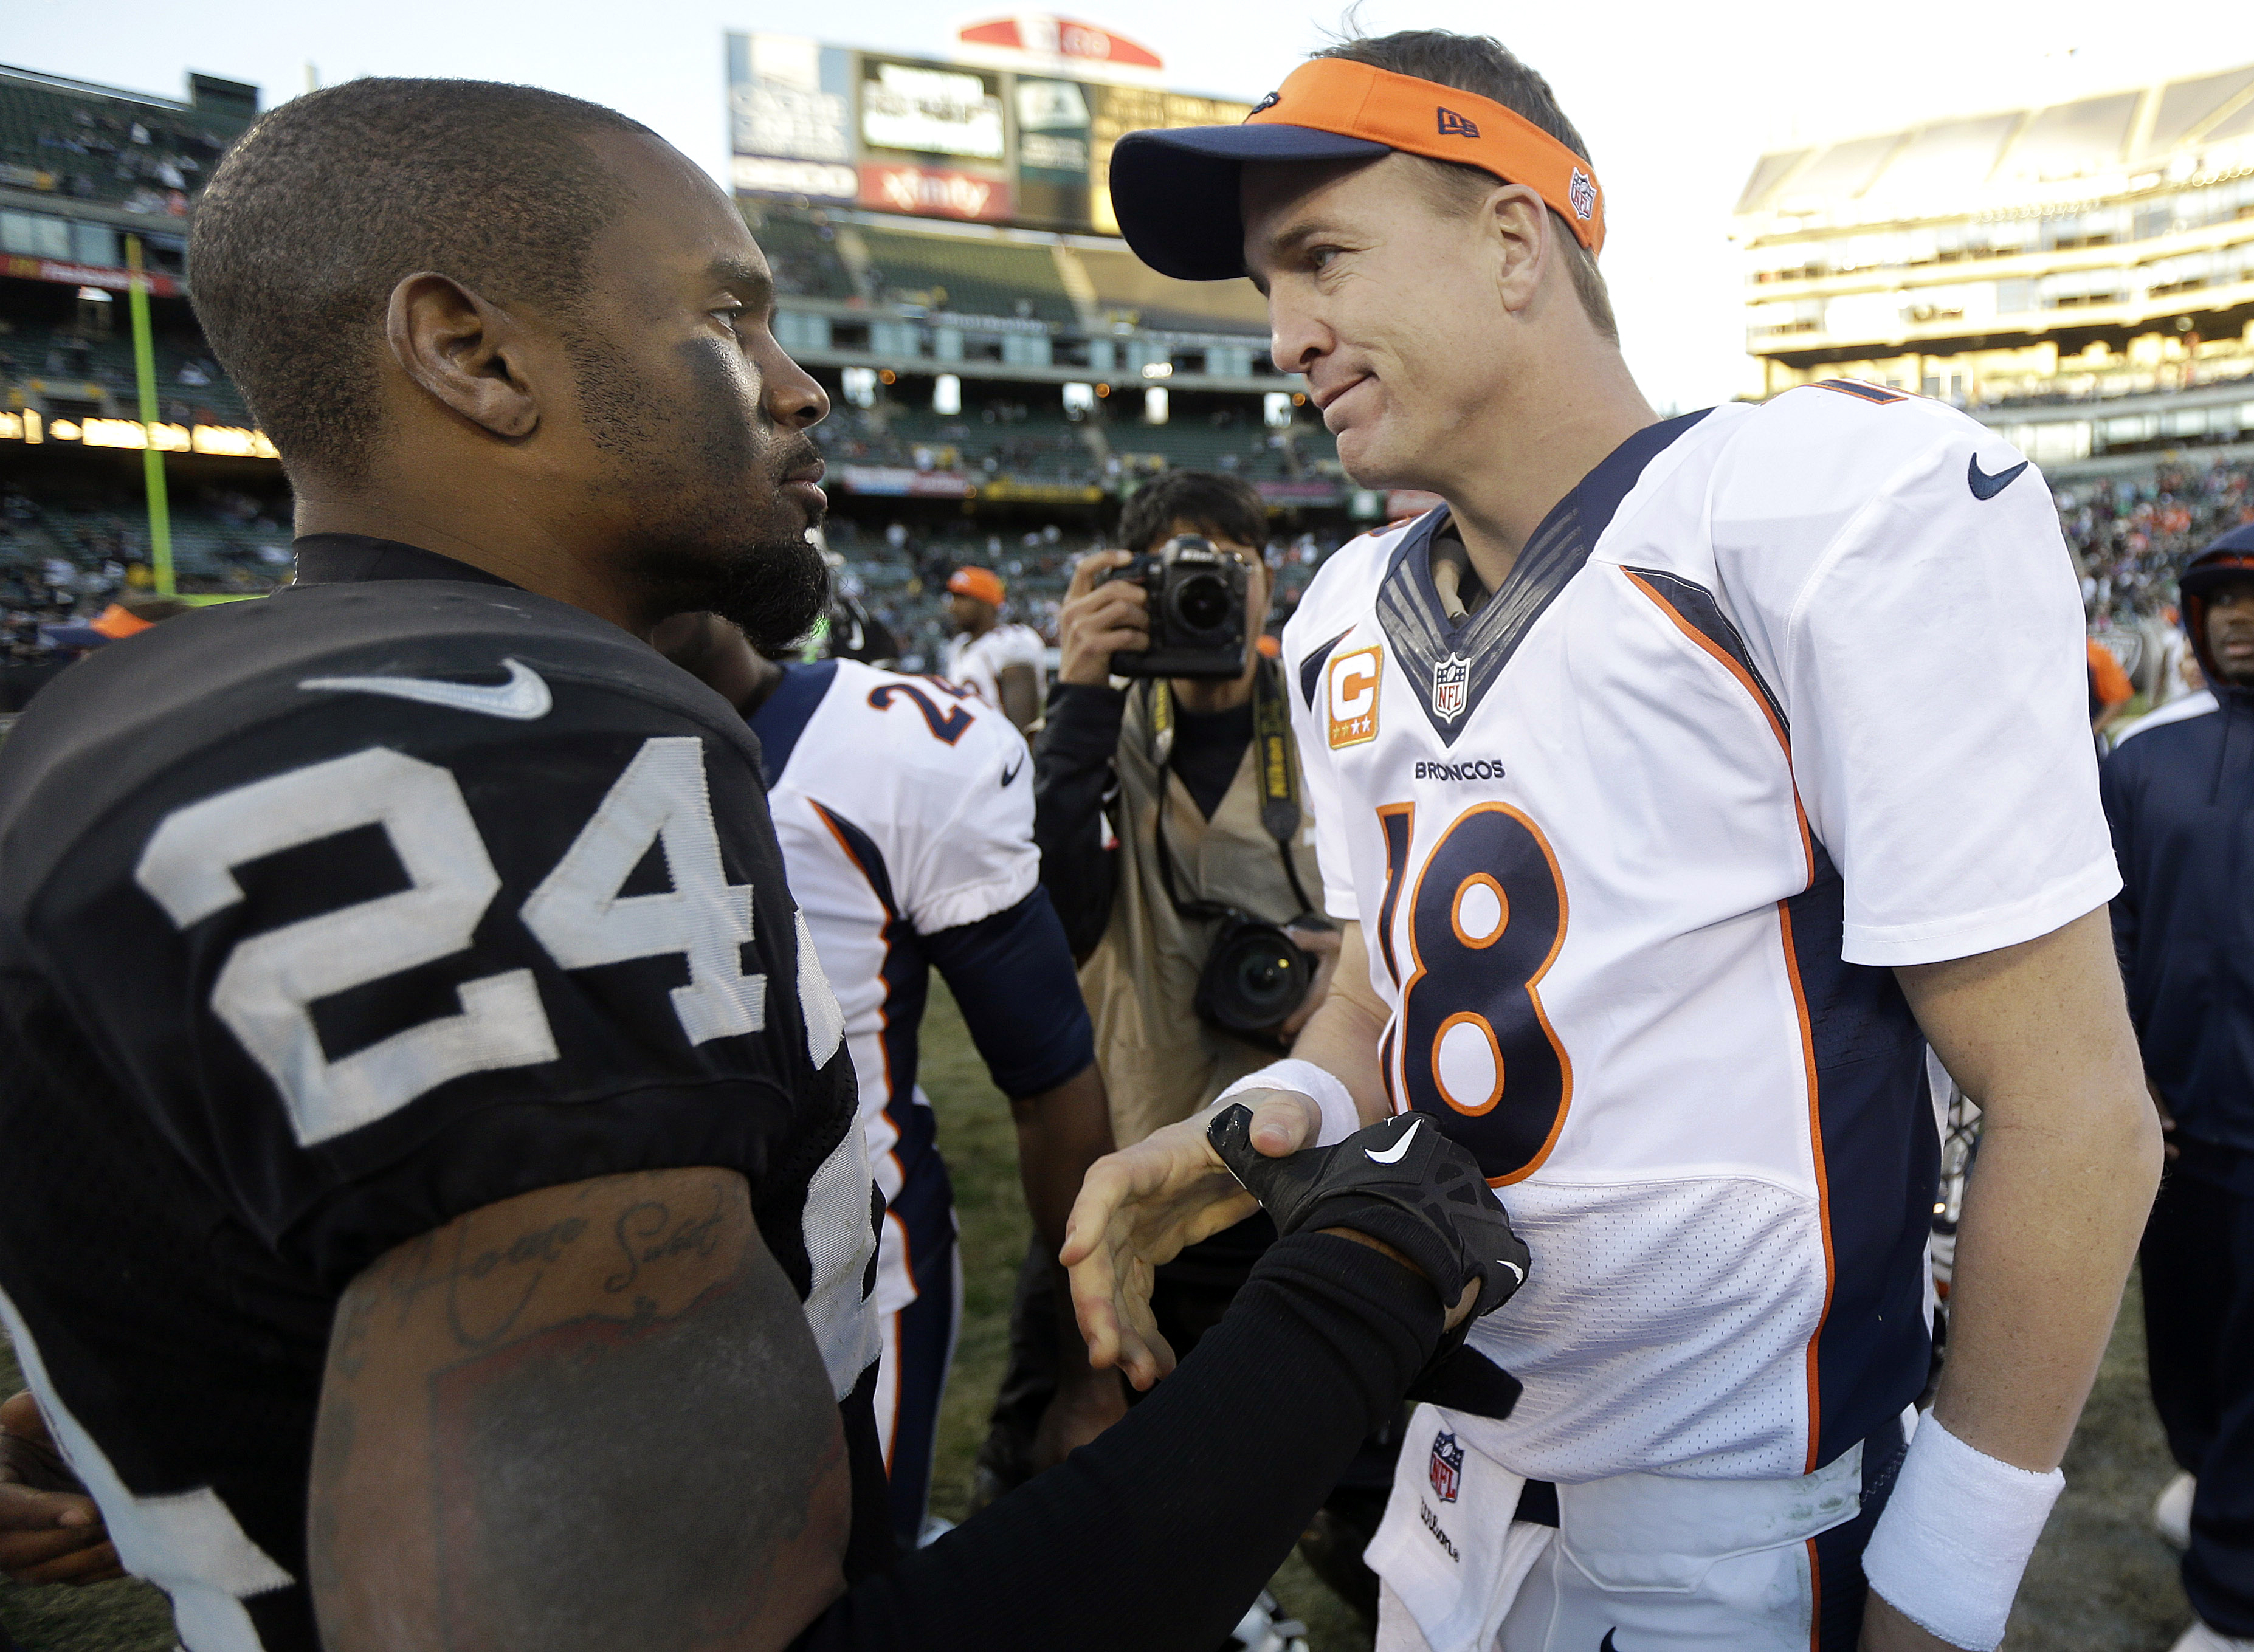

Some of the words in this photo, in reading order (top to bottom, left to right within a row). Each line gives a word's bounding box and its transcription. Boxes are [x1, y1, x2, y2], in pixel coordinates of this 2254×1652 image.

[1573, 187, 1590, 215] NFL
[1332, 652, 1376, 722] C
[1438, 684, 1461, 711] NFL
[1415, 759, 1506, 781] BRONCOS
[135, 736, 767, 1148] 24
[1376, 800, 1574, 1188] 18
[1430, 1453, 1456, 1498] NFL
